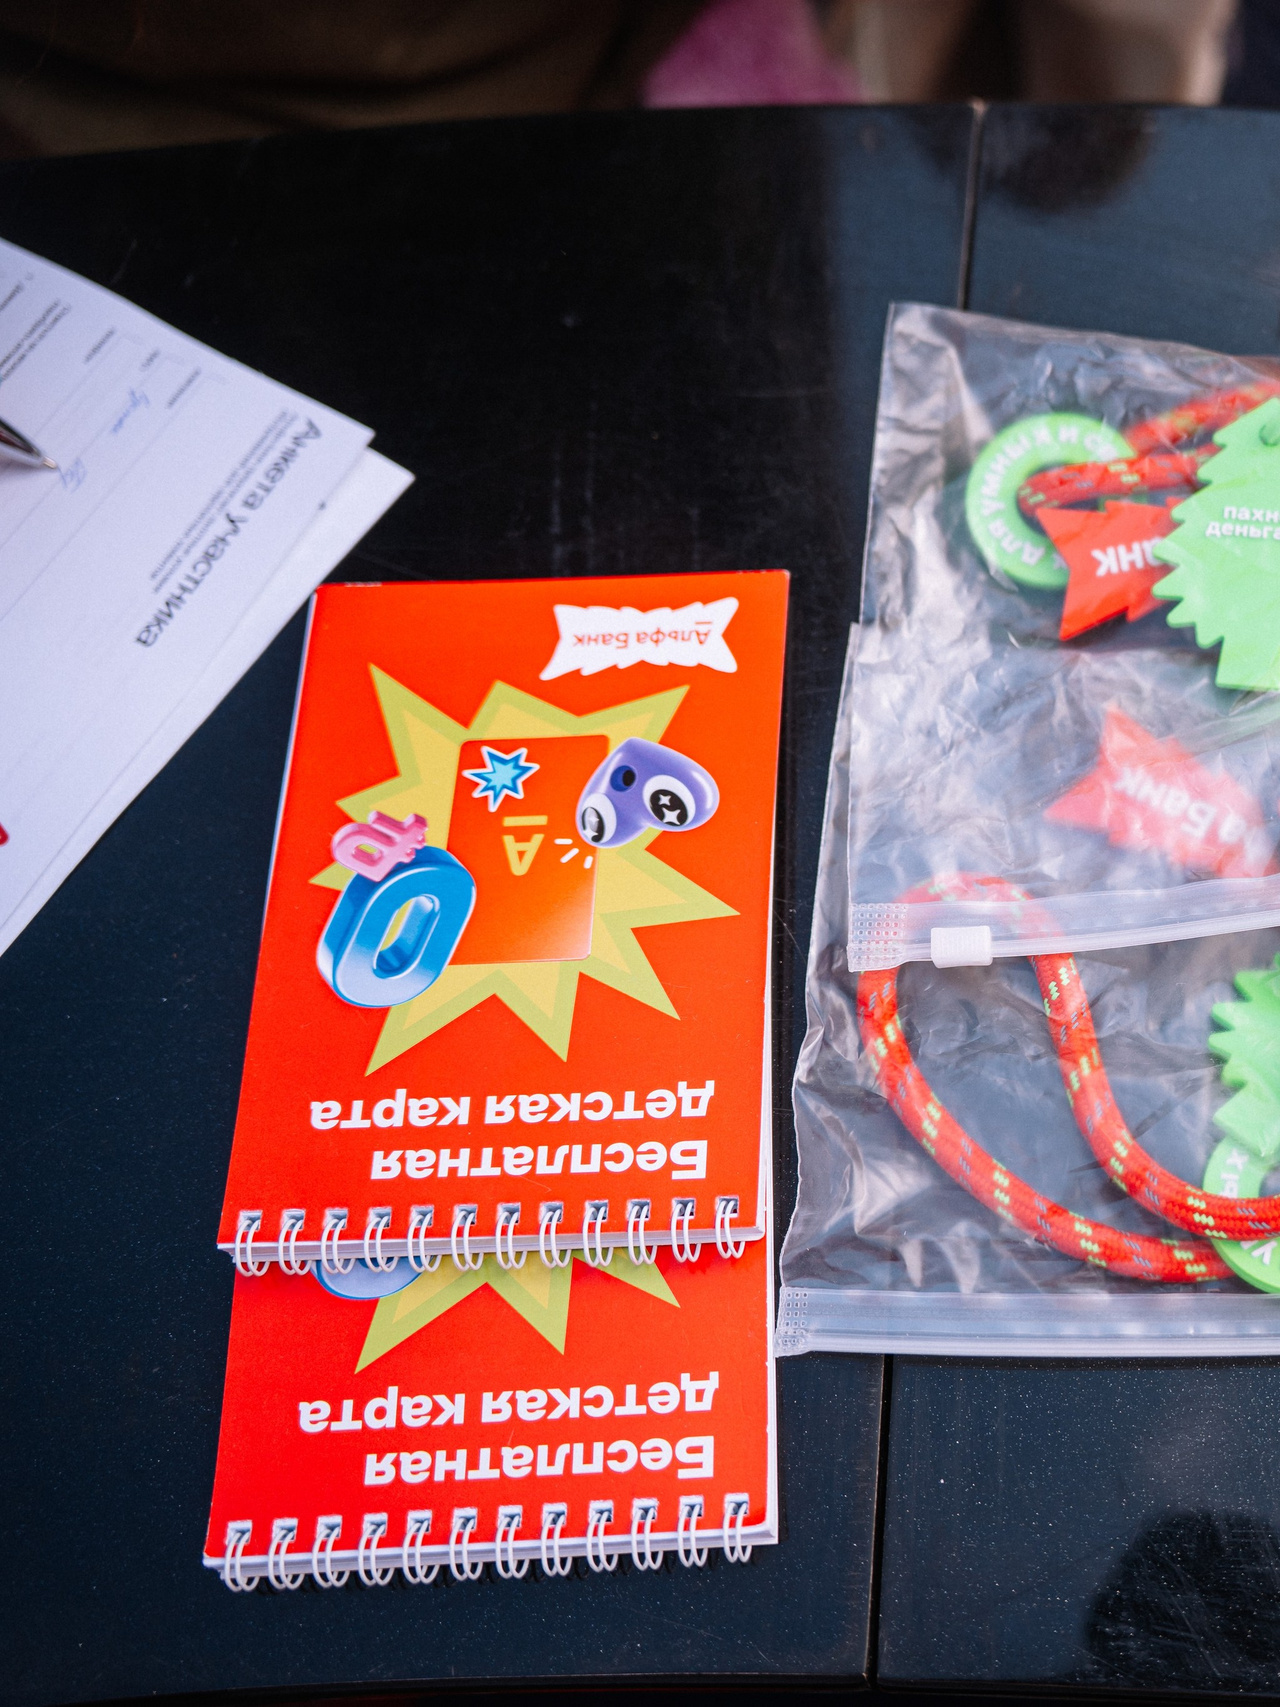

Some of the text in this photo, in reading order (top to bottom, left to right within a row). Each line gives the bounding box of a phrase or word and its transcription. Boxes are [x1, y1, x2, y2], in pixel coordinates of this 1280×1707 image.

[242, 417, 321, 510] Анкета
[136, 513, 248, 647] участника
[1091, 537, 1164, 577] анк
[572, 622, 712, 649] Альфа Банк
[309, 1080, 715, 1130] детская карта
[370, 1140, 708, 1181] Бесплатная
[298, 1371, 719, 1433] детская карта
[363, 1435, 715, 1486] Бесплатная
